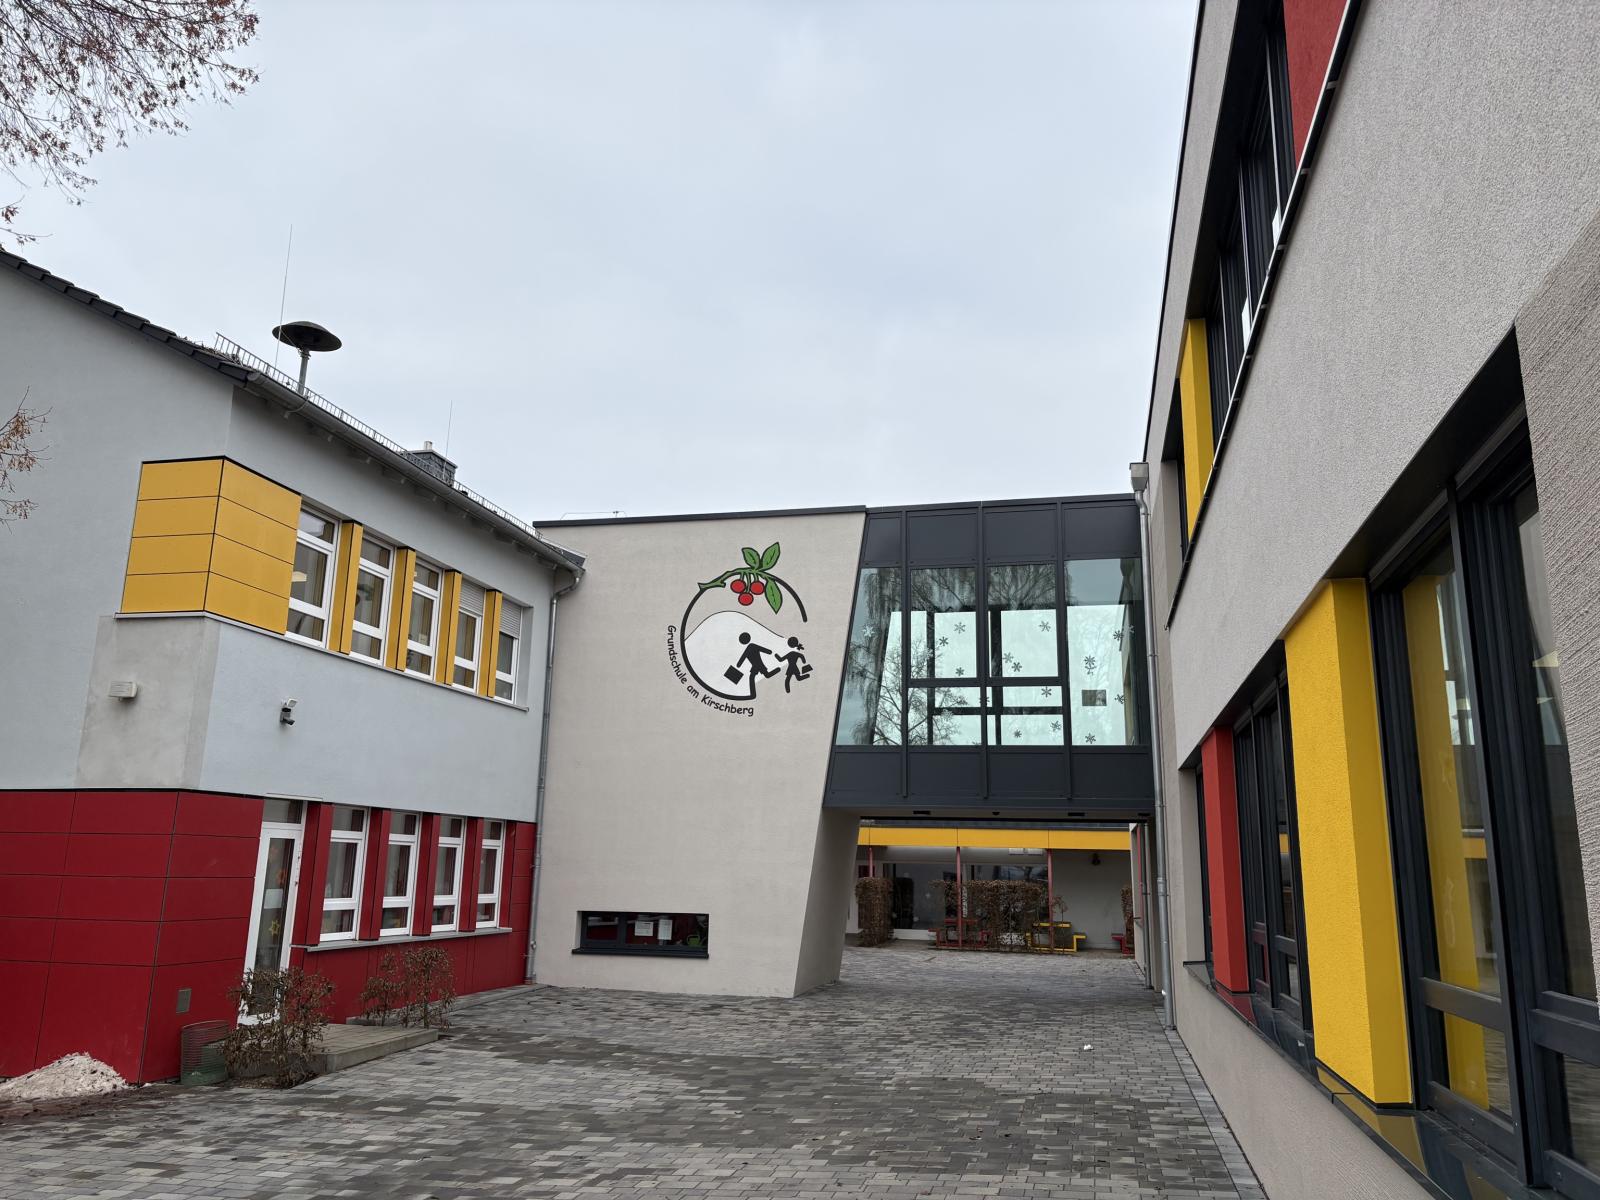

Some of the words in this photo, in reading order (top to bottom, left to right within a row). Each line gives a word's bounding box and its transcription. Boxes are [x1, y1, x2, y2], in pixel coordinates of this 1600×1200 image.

[667, 625, 687, 684] Grundschule
[687, 685, 699, 699] am
[701, 694, 754, 717] Kirschberg
